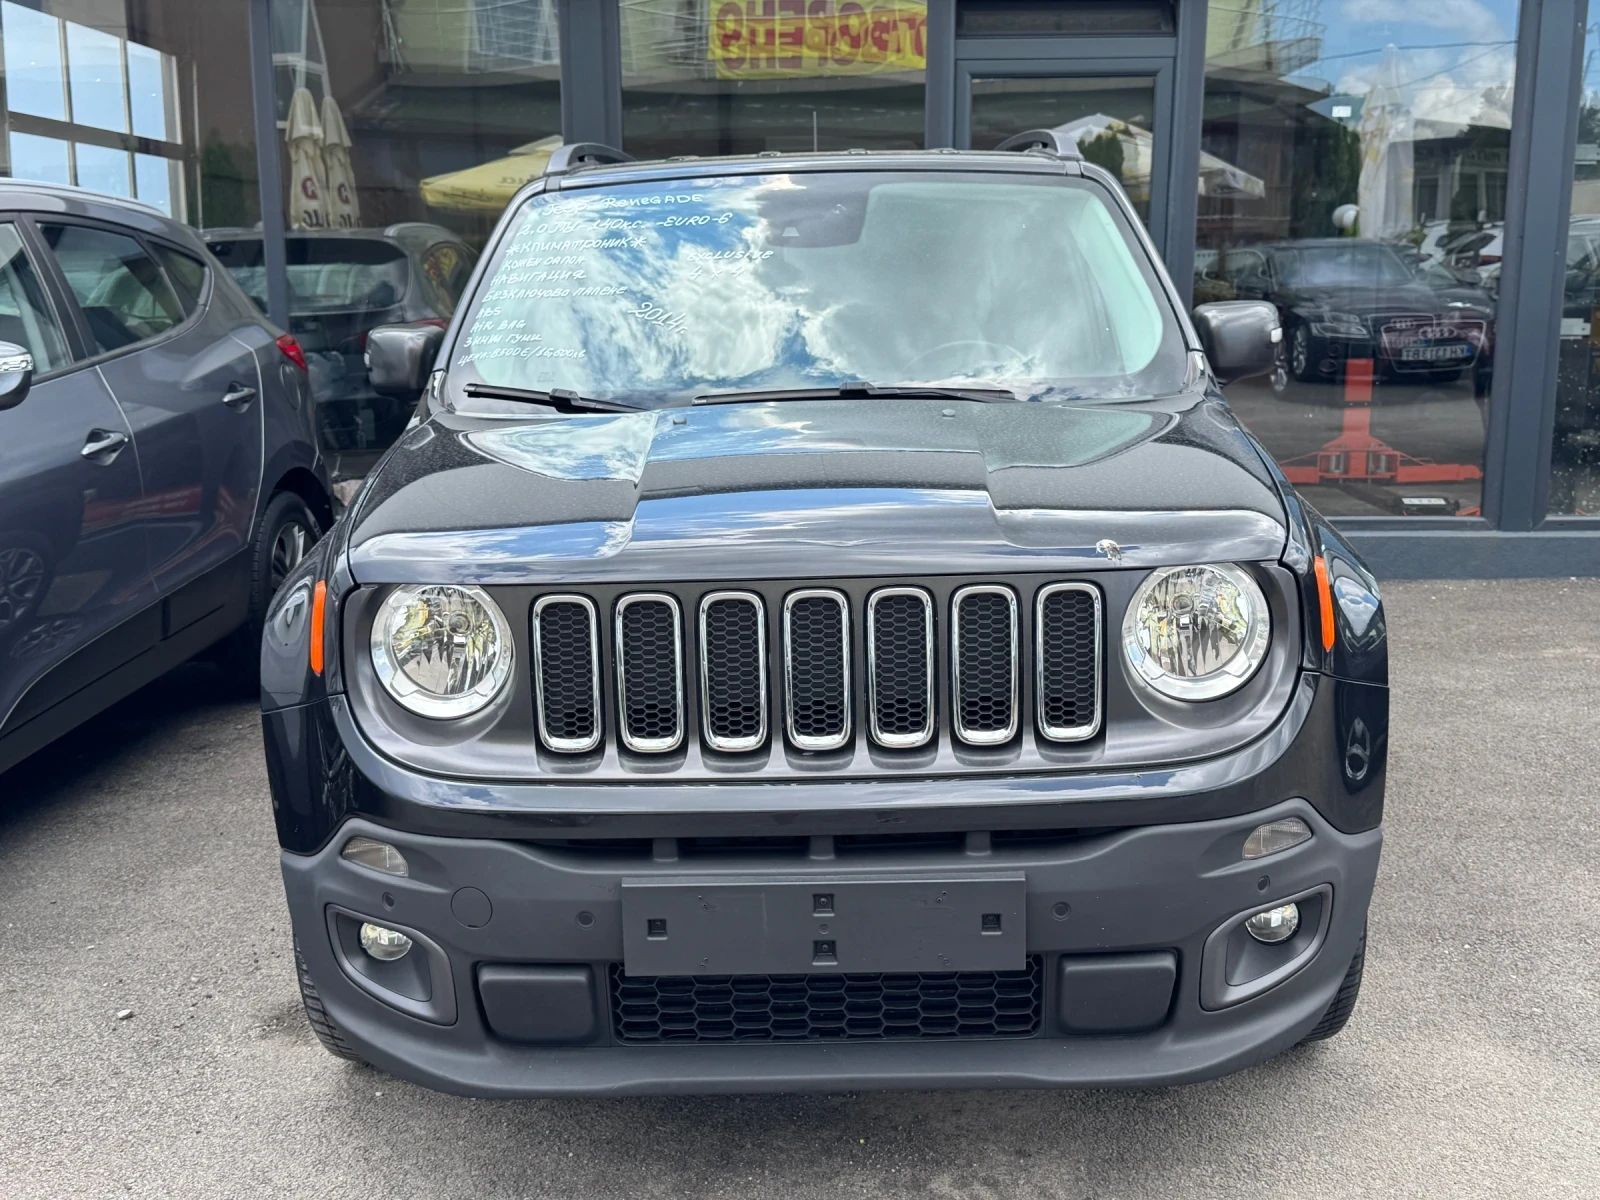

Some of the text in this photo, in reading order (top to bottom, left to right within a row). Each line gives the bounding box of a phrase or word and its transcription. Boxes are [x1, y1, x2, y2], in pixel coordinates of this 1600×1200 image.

[502, 257, 543, 271] КОЖЕН
[490, 269, 587, 287] НАВИГАЦИЯ
[475, 306, 503, 320] ABS
[496, 319, 528, 332] BAG
